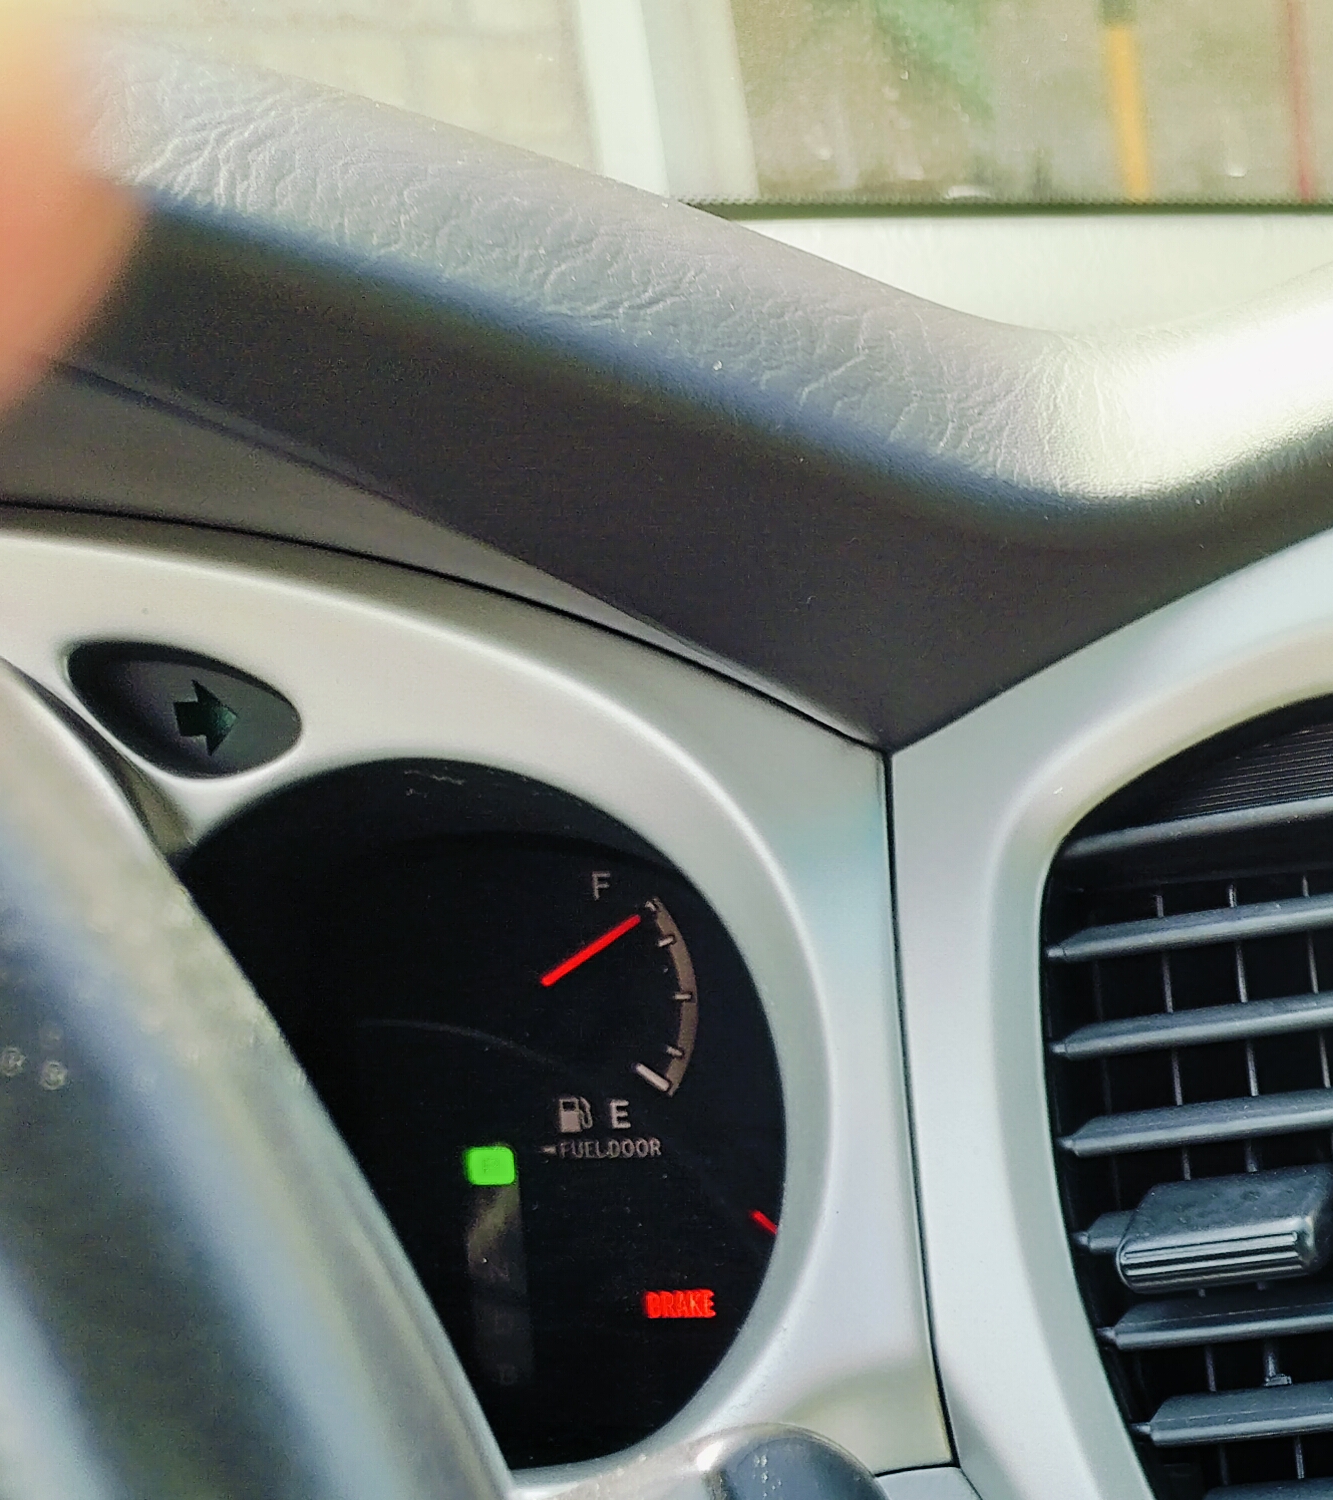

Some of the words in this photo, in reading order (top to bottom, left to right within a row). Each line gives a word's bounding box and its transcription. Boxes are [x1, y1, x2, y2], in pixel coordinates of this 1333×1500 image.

[591, 870, 611, 899] F
[608, 1099, 632, 1130] E
[644, 1289, 717, 1319] BRAKE
